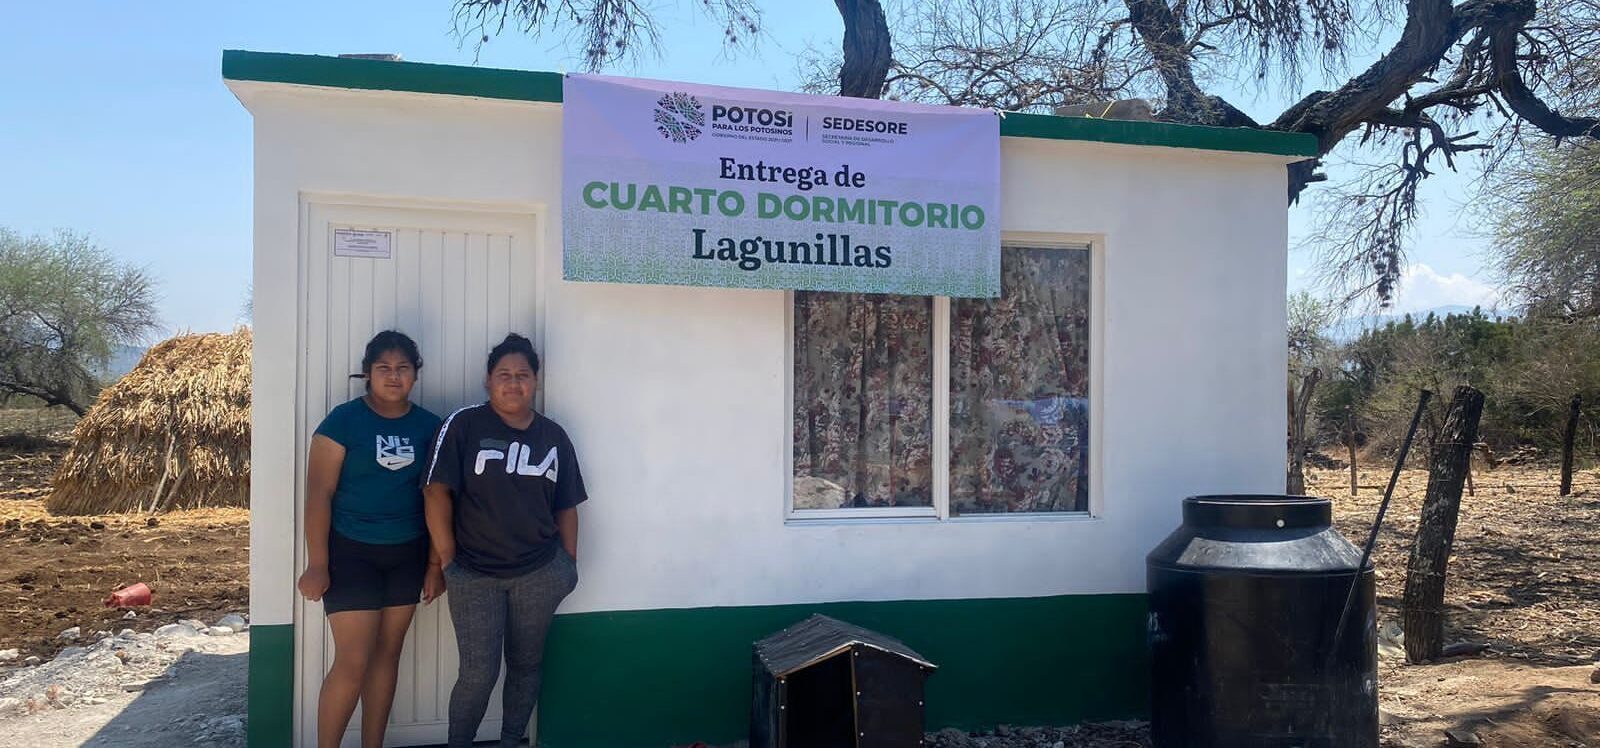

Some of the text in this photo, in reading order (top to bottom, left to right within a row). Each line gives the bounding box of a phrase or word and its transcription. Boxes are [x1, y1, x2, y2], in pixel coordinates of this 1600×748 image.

[712, 123, 793, 136] PARA LOS POTOSINOS
[822, 117, 908, 135] SEDESORE
[719, 157, 866, 191] Entrega de
[582, 181, 985, 230] CUARTO DORMITORIO
[692, 229, 892, 271] Lagunillas
[474, 439, 559, 483] FILA
